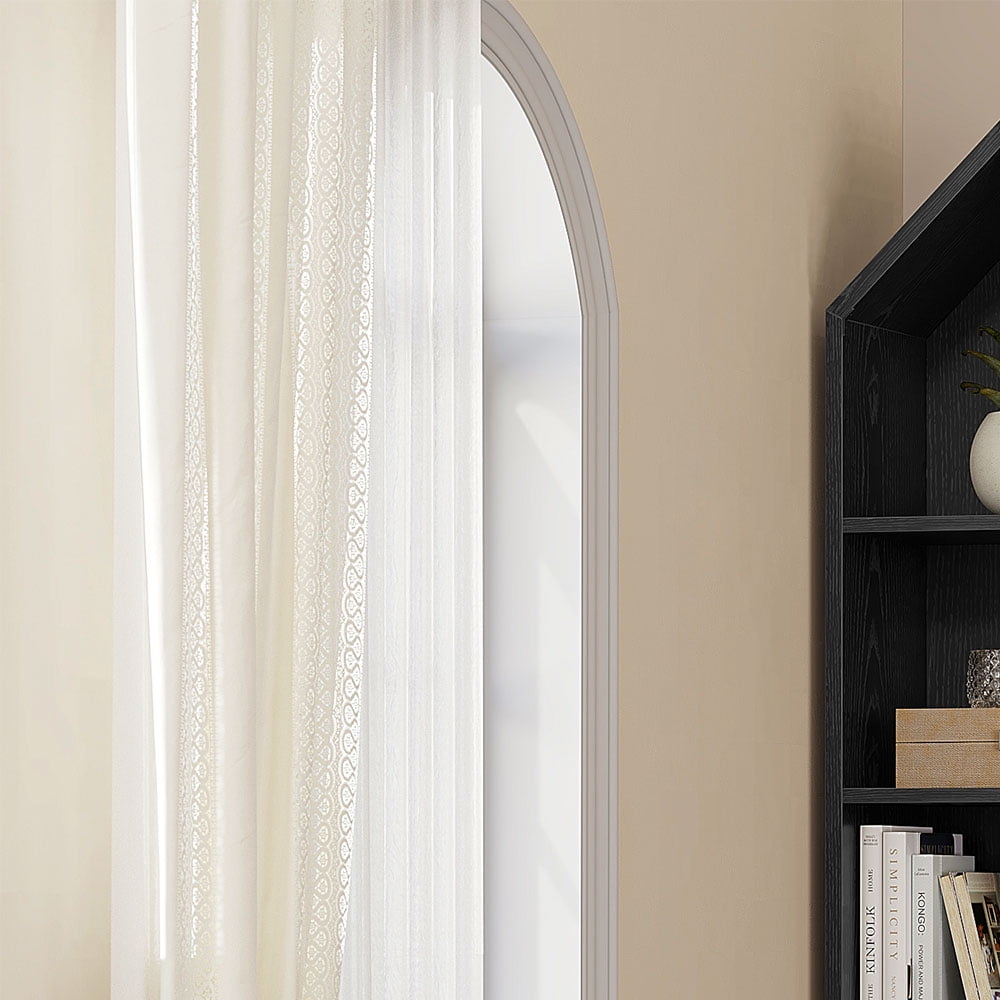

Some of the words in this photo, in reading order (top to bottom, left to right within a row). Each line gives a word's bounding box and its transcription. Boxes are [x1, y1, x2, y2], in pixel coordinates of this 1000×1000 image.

[889, 848, 899, 961] SIMPLICITY
[917, 892, 926, 936] KONGO:
[865, 906, 876, 974] KINFOLK
